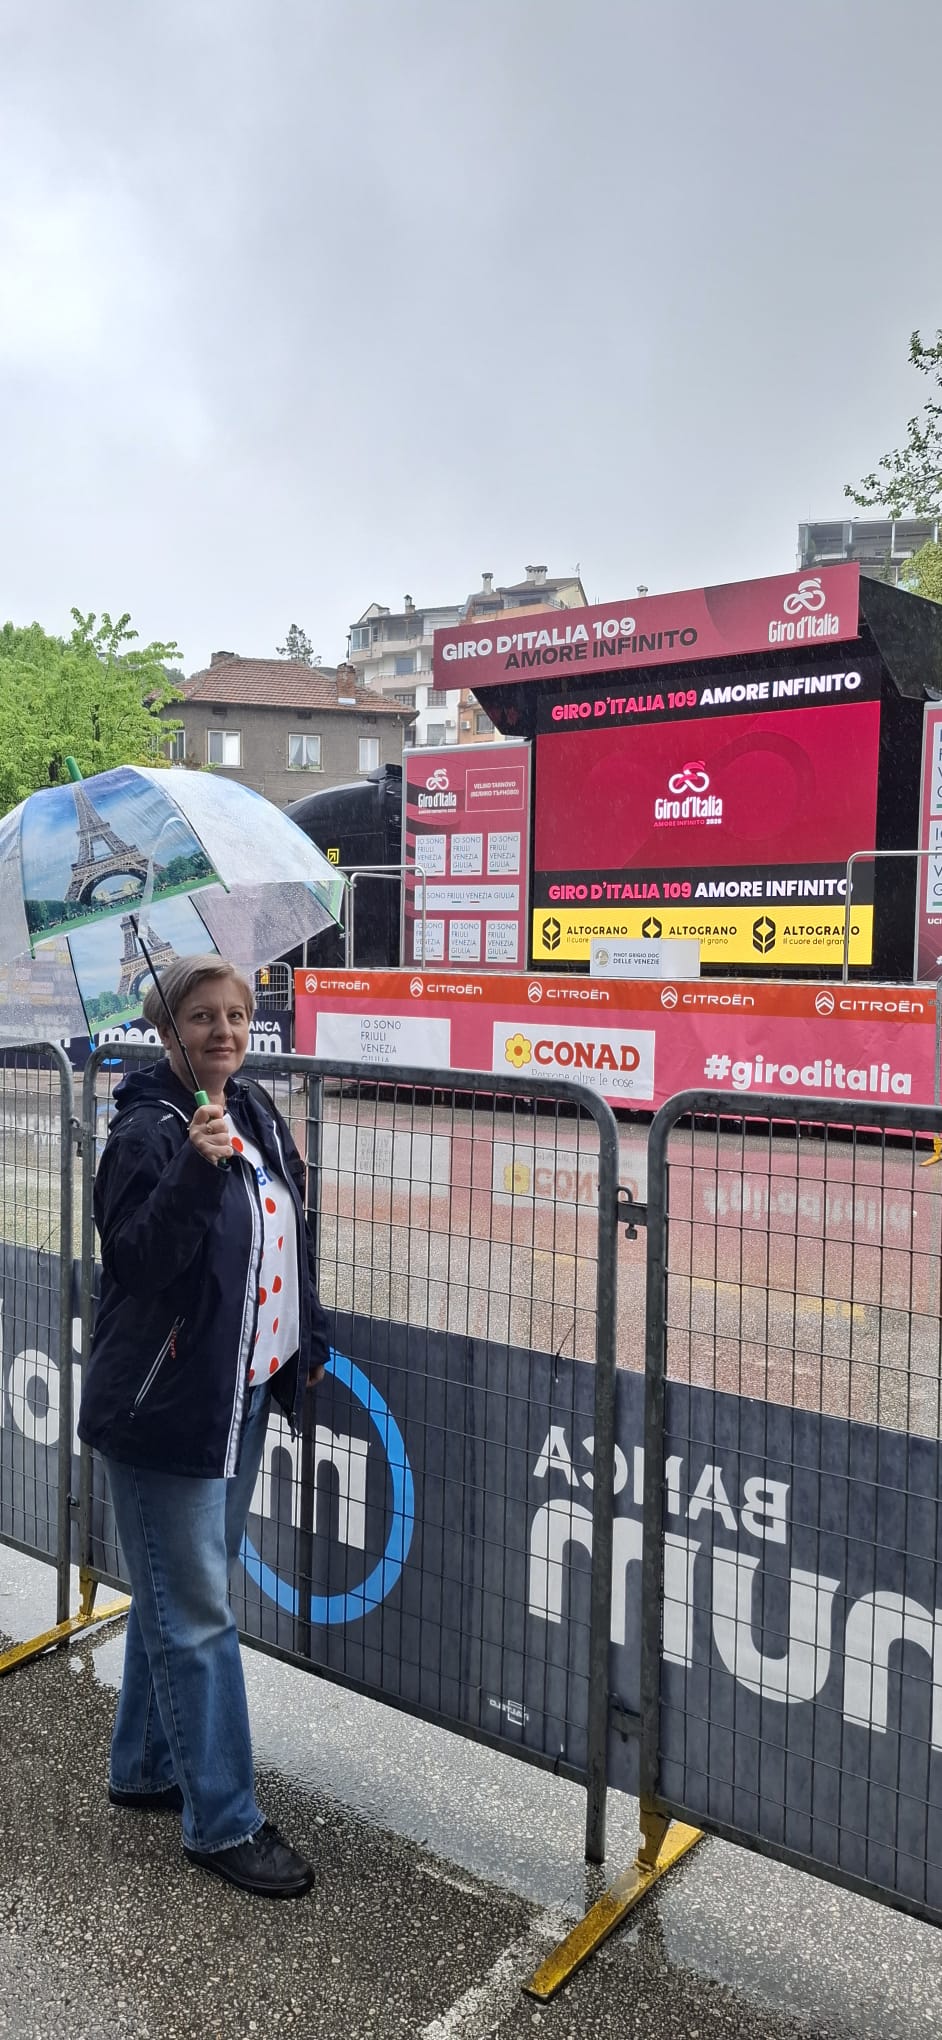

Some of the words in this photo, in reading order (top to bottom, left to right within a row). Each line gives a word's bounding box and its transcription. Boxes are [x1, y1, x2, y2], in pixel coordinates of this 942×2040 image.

[768, 621, 793, 643] Giro
[442, 638, 493, 662] GIRO
[592, 617, 637, 640] 109
[504, 642, 588, 670] AMORE
[592, 627, 699, 658] INFINITO
[551, 703, 592, 721] GIRO
[667, 690, 698, 708] 109
[700, 681, 769, 705] AMORE
[772, 671, 862, 698] INFINITO
[418, 794, 433, 807] Giro
[655, 797, 680, 820] Giro
[676, 819, 705, 827] INFINITO
[463, 836, 481, 844] SONO
[499, 835, 519, 843] SONO
[453, 853, 479, 861] VENEZIA
[489, 852, 516, 860] VENEZIA
[489, 861, 510, 869] GIULIA
[549, 884, 589, 900] GIRO
[662, 880, 692, 898] 109
[694, 880, 762, 899] AMORE
[765, 878, 854, 897] INFINITO
[466, 891, 492, 899] VENEZIA
[493, 891, 515, 899] GIULIA
[460, 922, 480, 930] SONO
[566, 926, 629, 935] ALTOGRANO
[669, 926, 738, 936] ALTOGRANO
[707, 938, 729, 946] grano
[812, 937, 825, 945] del
[249, 1021, 281, 1033] ANCA
[360, 1019, 371, 1029] IO
[373, 1019, 401, 1030] SONO
[360, 1031, 386, 1041] FRIULI
[360, 1043, 397, 1054] VENEZIA
[534, 1040, 640, 1072] CONAD
[703, 1054, 912, 1095] #giroditalia
[612, 1077, 634, 1088] cose
